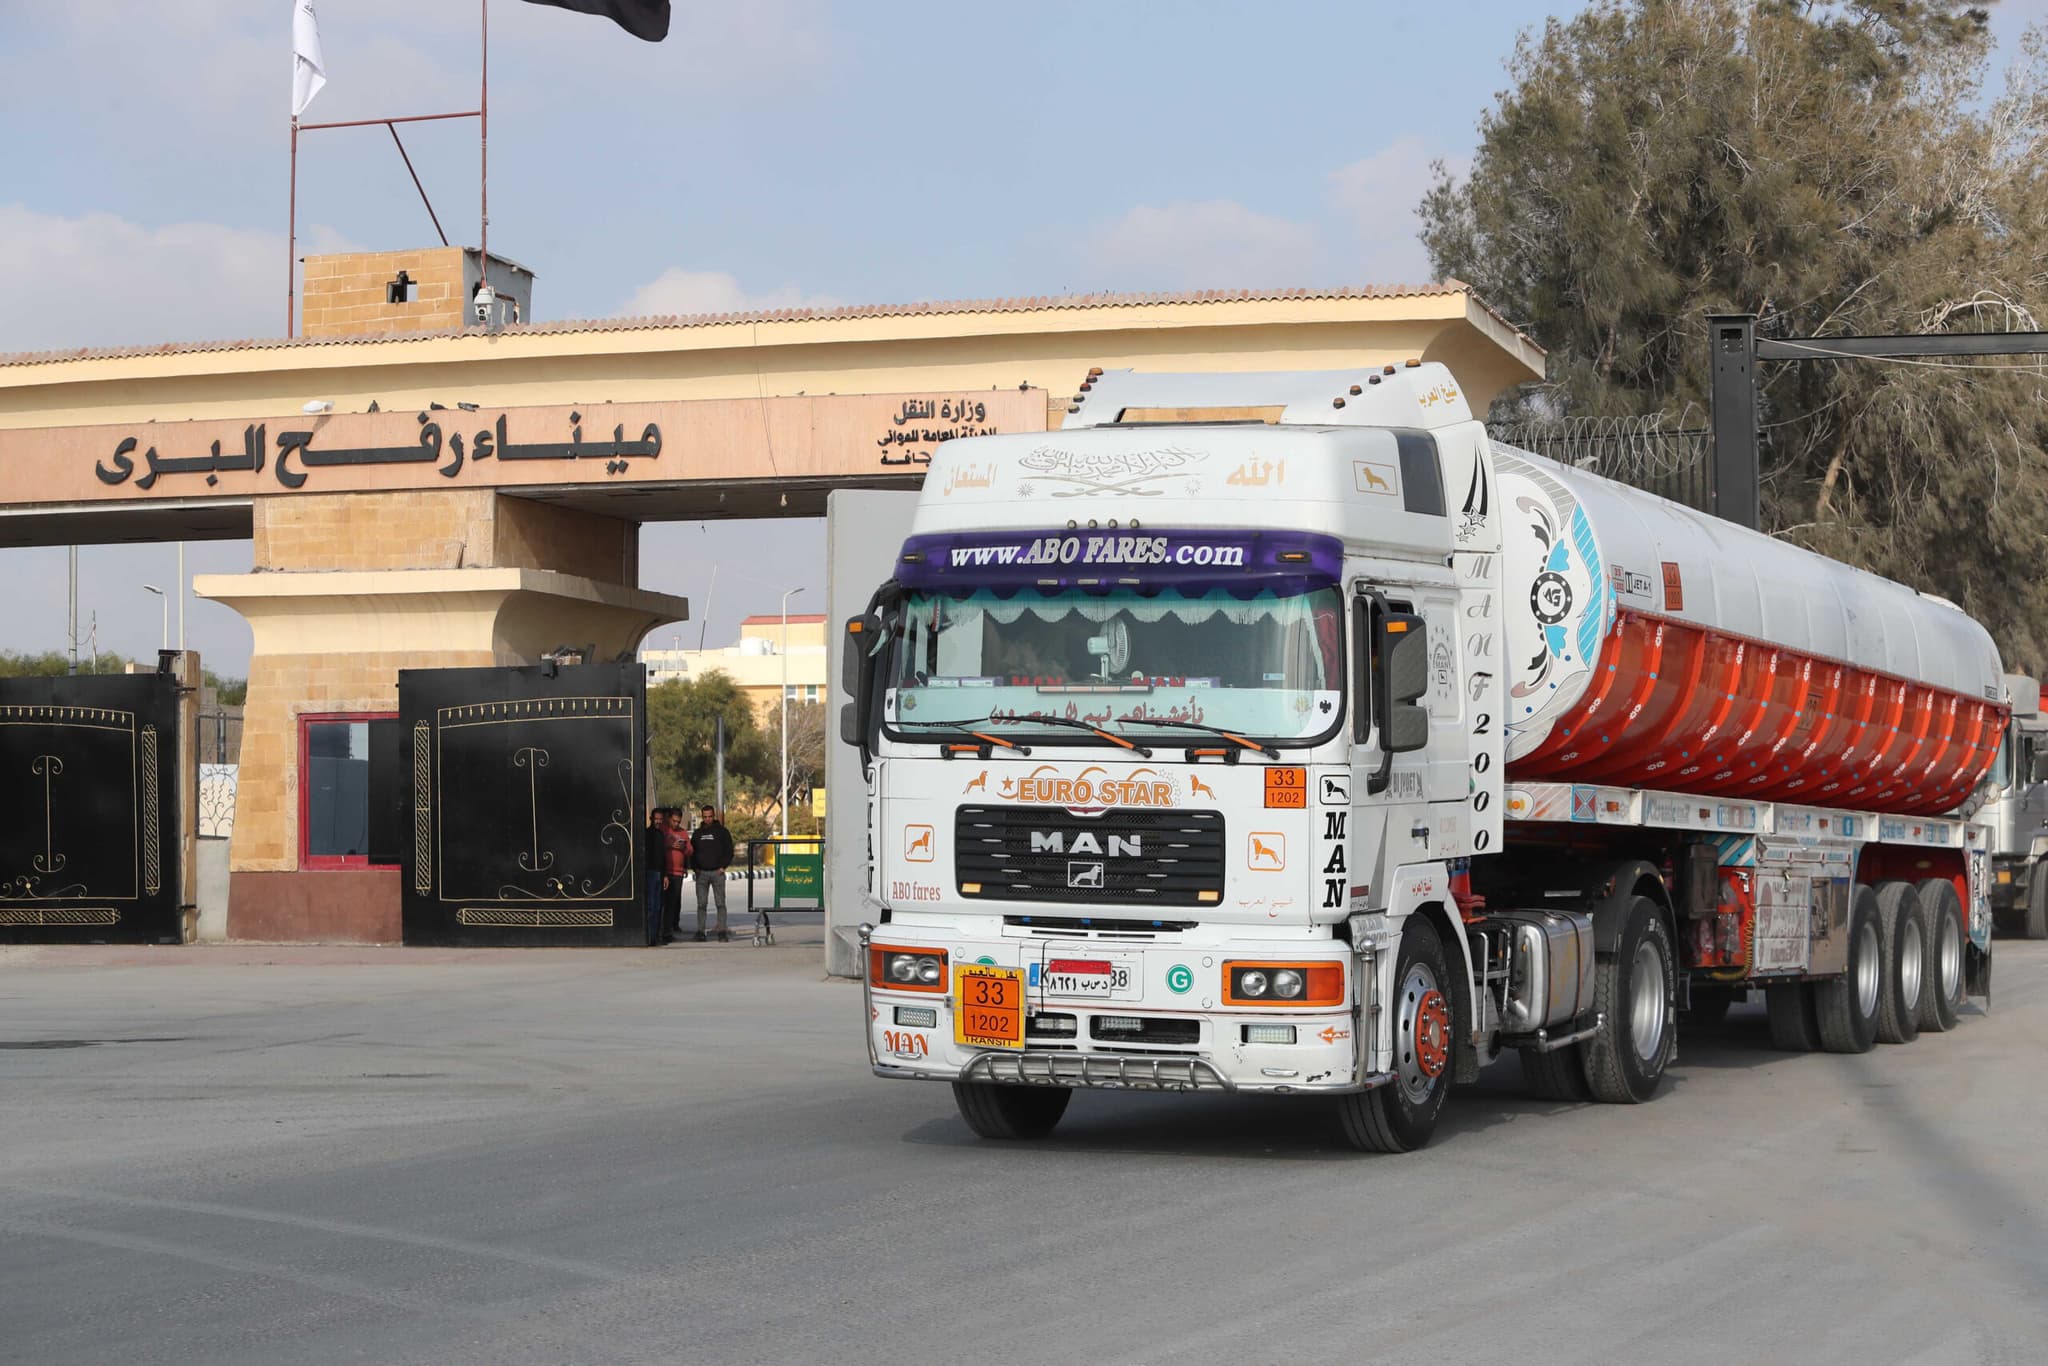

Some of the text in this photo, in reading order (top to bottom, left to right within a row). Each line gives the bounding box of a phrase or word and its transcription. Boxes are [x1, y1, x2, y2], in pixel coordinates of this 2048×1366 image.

[893, 399, 986, 425] وزارة النقل
[275, 410, 464, 489] رفح
[471, 410, 663, 476] ميناء
[1225, 455, 1285, 488] الله
[1272, 769, 1296, 786] 33
[1017, 778, 1174, 806] EURO STAR
[1269, 792, 1300, 805] 1202
[1030, 831, 1143, 858] MAN
[1323, 811, 1347, 908] MAN
[892, 881, 941, 901] ABO fares
[976, 980, 1005, 1005] 33
[1170, 970, 1190, 989] G
[970, 1013, 1009, 1033] 1202
[883, 1029, 930, 1057] MAN
[965, 1036, 1012, 1047] TRANSIT
